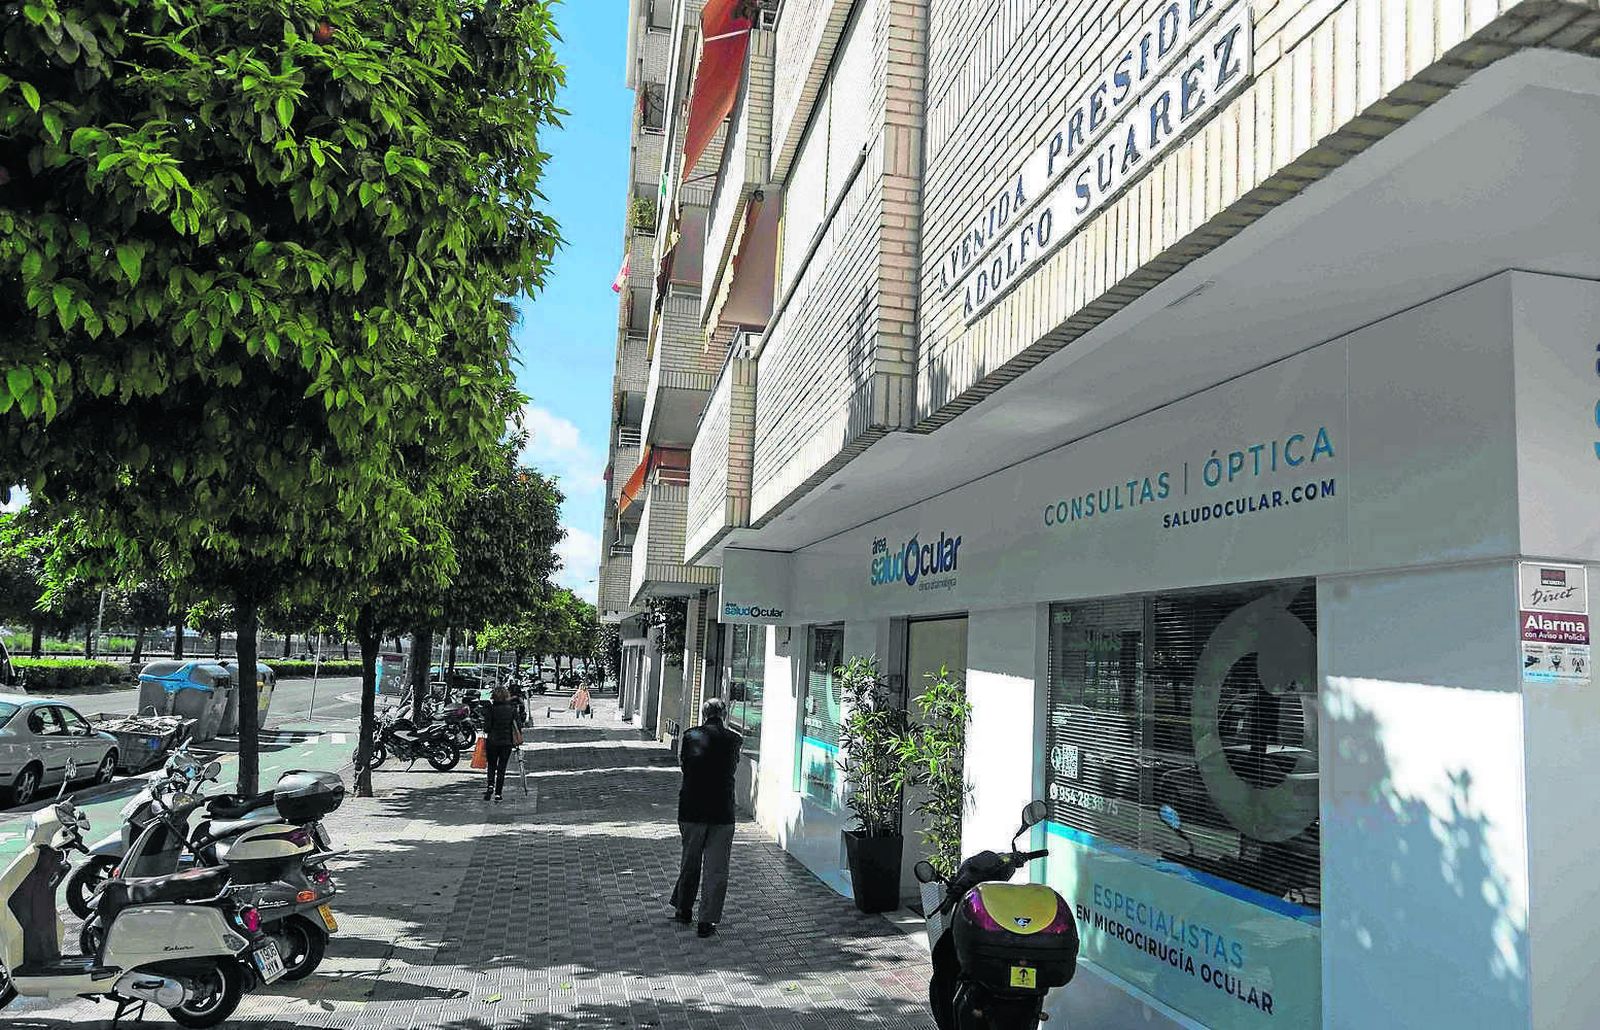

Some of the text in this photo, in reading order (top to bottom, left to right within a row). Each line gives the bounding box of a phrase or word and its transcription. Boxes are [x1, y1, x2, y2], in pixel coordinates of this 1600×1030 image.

[963, 22, 1242, 318] ADOLFO SUAREZ
[938, 174, 1027, 293] AVENIDA
[1044, 426, 1335, 527] CONSULTAS ÓPTICA
[1163, 479, 1336, 528] SALUDOCULAR.COM
[1525, 615, 1586, 633] Alarma
[1531, 587, 1579, 605] Direct
[1539, 631, 1558, 640] Aviso
[1076, 904, 1274, 1015] EN MICROCIRUGÍA OCULAR
[1093, 883, 1244, 969] ESPECIALISTAS
